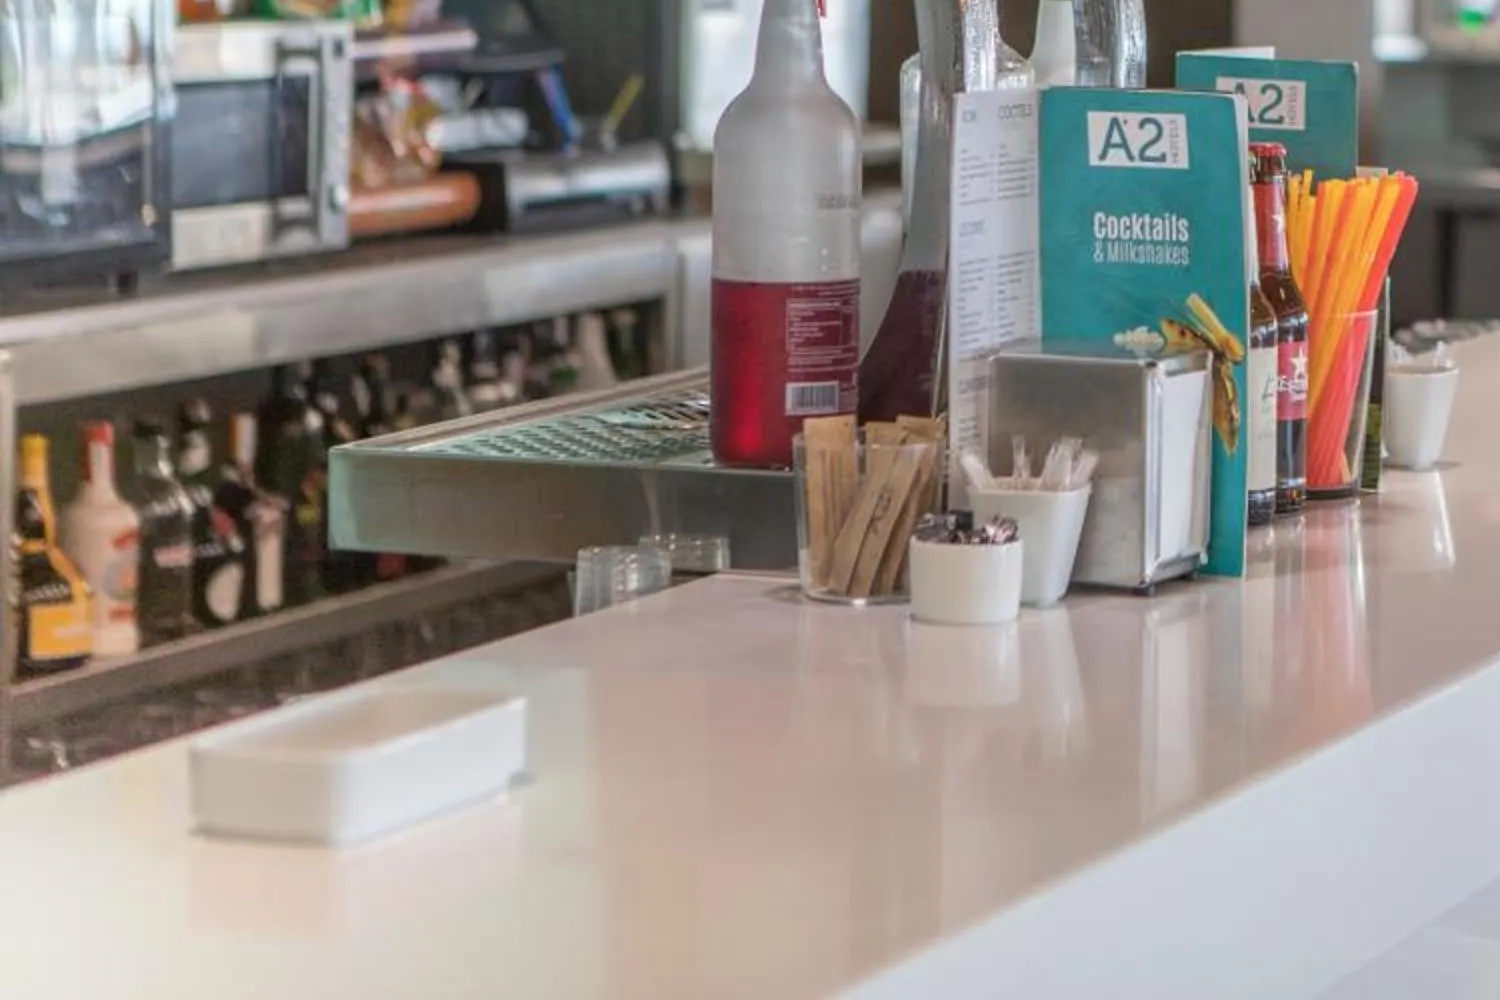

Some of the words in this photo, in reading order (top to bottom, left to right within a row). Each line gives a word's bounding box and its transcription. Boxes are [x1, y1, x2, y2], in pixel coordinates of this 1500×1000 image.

[1098, 116, 1167, 163] A2
[1093, 211, 1190, 242] Cocktails
[1093, 241, 1104, 263] &
[1106, 241, 1190, 266] Milkshakes
